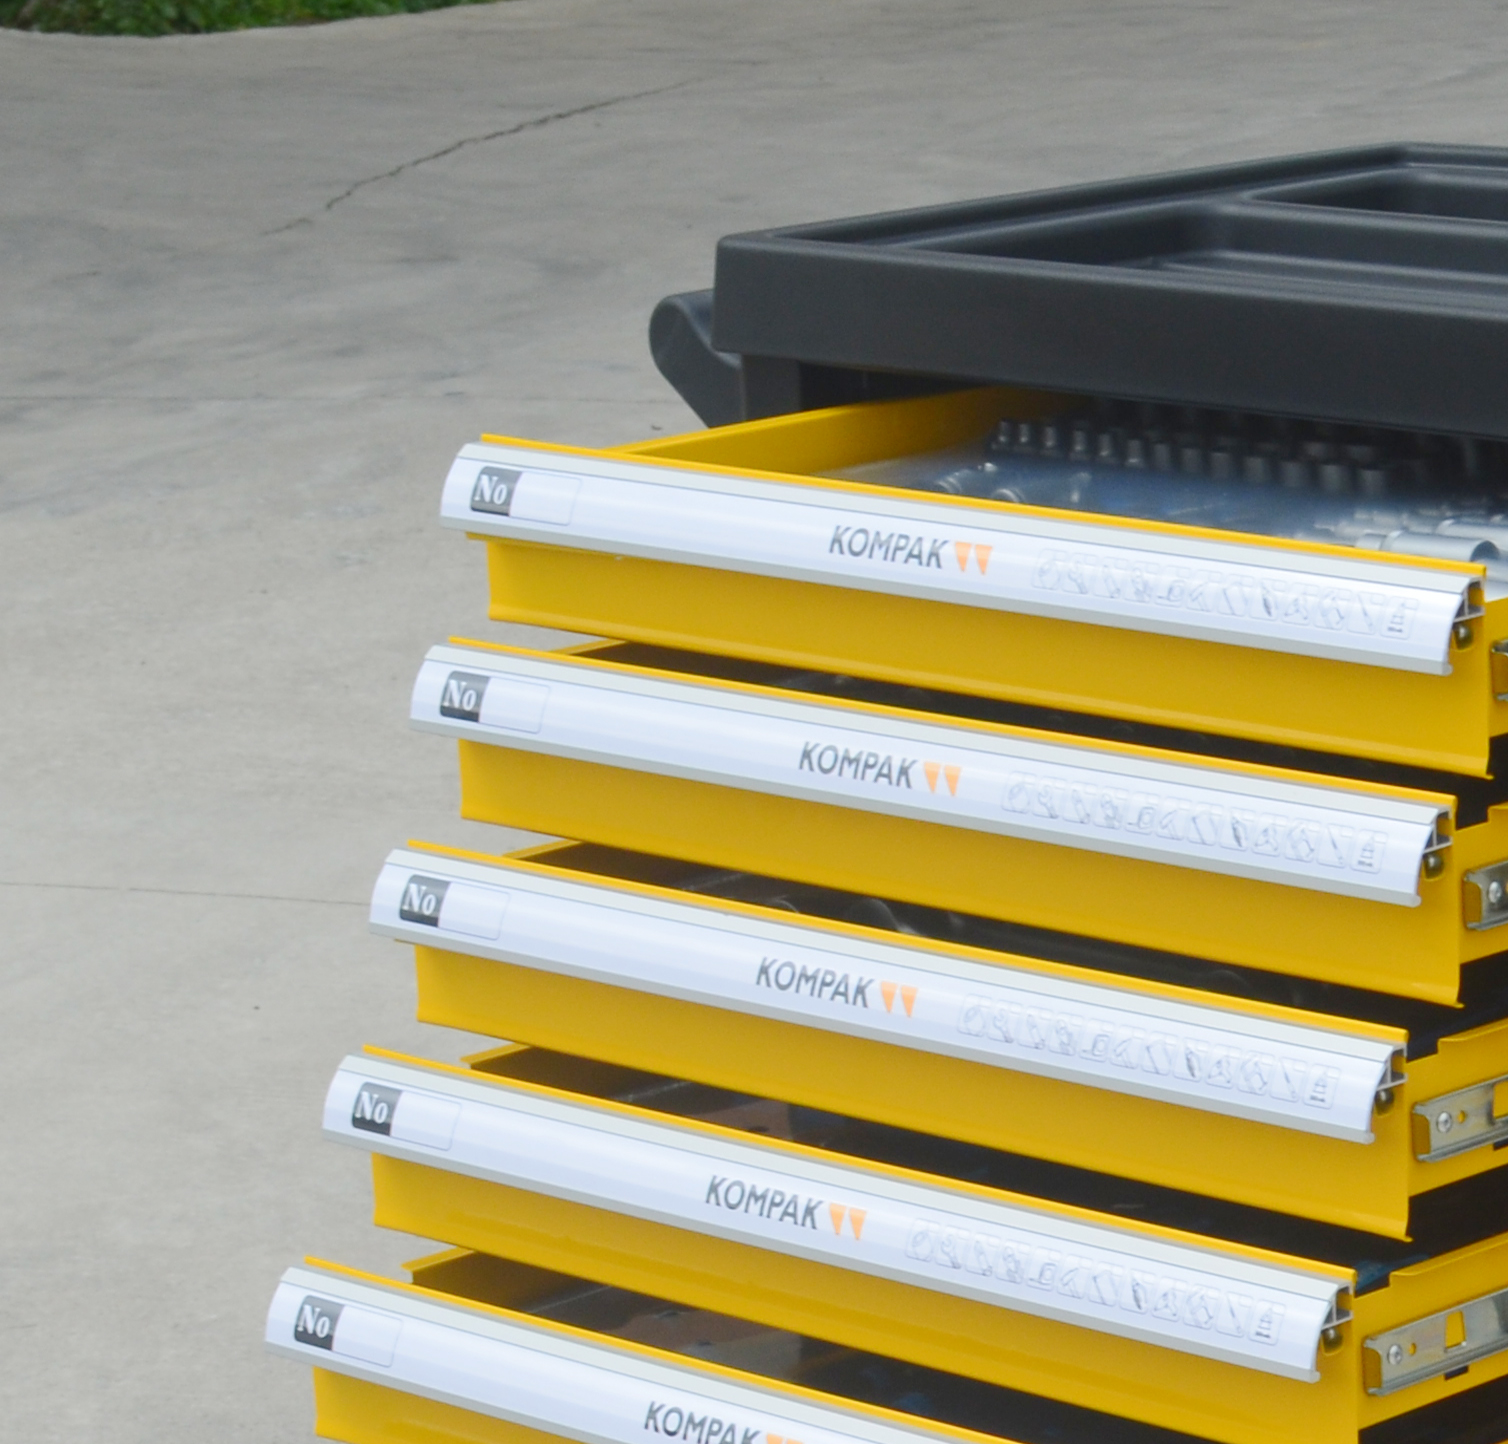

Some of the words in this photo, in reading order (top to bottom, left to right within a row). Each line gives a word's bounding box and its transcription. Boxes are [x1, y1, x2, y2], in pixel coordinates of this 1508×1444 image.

[473, 475, 508, 505] No
[829, 525, 949, 570] KOMPAK
[442, 680, 476, 712] No
[798, 741, 918, 789] KOMPAK
[401, 884, 437, 915] No
[756, 957, 875, 1009] KOMPAK
[353, 1092, 388, 1125] No
[706, 1175, 824, 1230] KOMPAK
[296, 1305, 331, 1337] No
